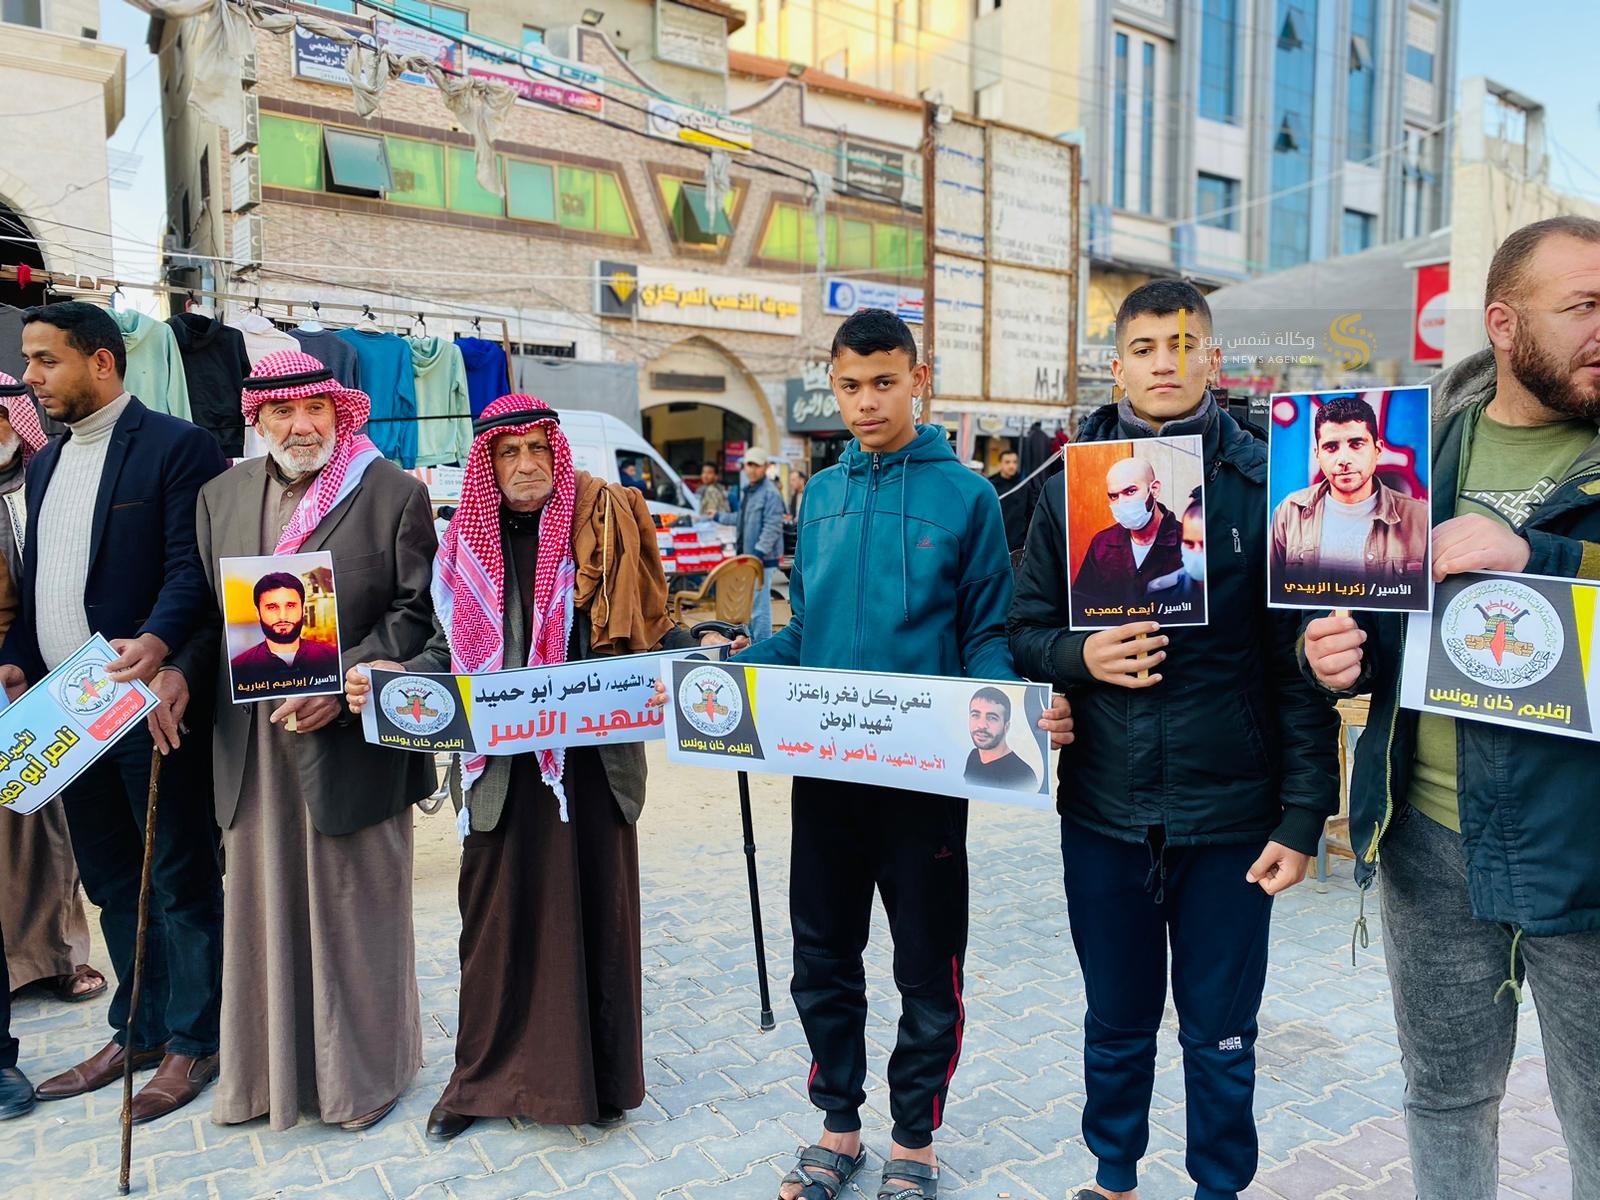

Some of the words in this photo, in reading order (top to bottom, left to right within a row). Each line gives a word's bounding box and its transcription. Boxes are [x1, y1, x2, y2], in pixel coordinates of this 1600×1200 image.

[641, 283, 708, 309] المركزي
[711, 289, 760, 311] الذهب
[761, 296, 799, 319] سوق
[1284, 582, 1331, 594] الزبيدي
[1335, 582, 1366, 596] زكريا
[1084, 605, 1123, 617] كممجي
[1127, 602, 1155, 616] أيهم
[238, 680, 270, 692] إغبارية
[273, 677, 307, 689] إبراهيم
[531, 674, 553, 704] أبو
[558, 672, 600, 701] ناصر
[786, 682, 830, 704] واعتزاز
[475, 688, 525, 708] حميد
[834, 686, 859, 705] فخر
[862, 688, 898, 711] بكل
[901, 692, 932, 714] ننعي
[1429, 688, 1479, 709] يونس
[1483, 694, 1514, 711] خان
[820, 711, 856, 732] الوطن
[1518, 702, 1572, 724] إقليم
[488, 710, 567, 748] الأسر
[860, 714, 893, 735] شهيد
[8, 728, 36, 760] الأسير
[41, 725, 80, 768] ناصر
[381, 735, 410, 746] يونس
[413, 738, 431, 747] خان
[434, 738, 464, 749] إقليم
[681, 738, 707, 750] يونس
[709, 740, 725, 751] خان
[727, 742, 754, 756] إقليم
[777, 737, 814, 757] حميد
[819, 736, 837, 760] أبو
[842, 743, 877, 762] ناصر
[919, 753, 946, 771] الأسير
[20, 753, 48, 786] أبو
[0, 780, 26, 806] حمي
